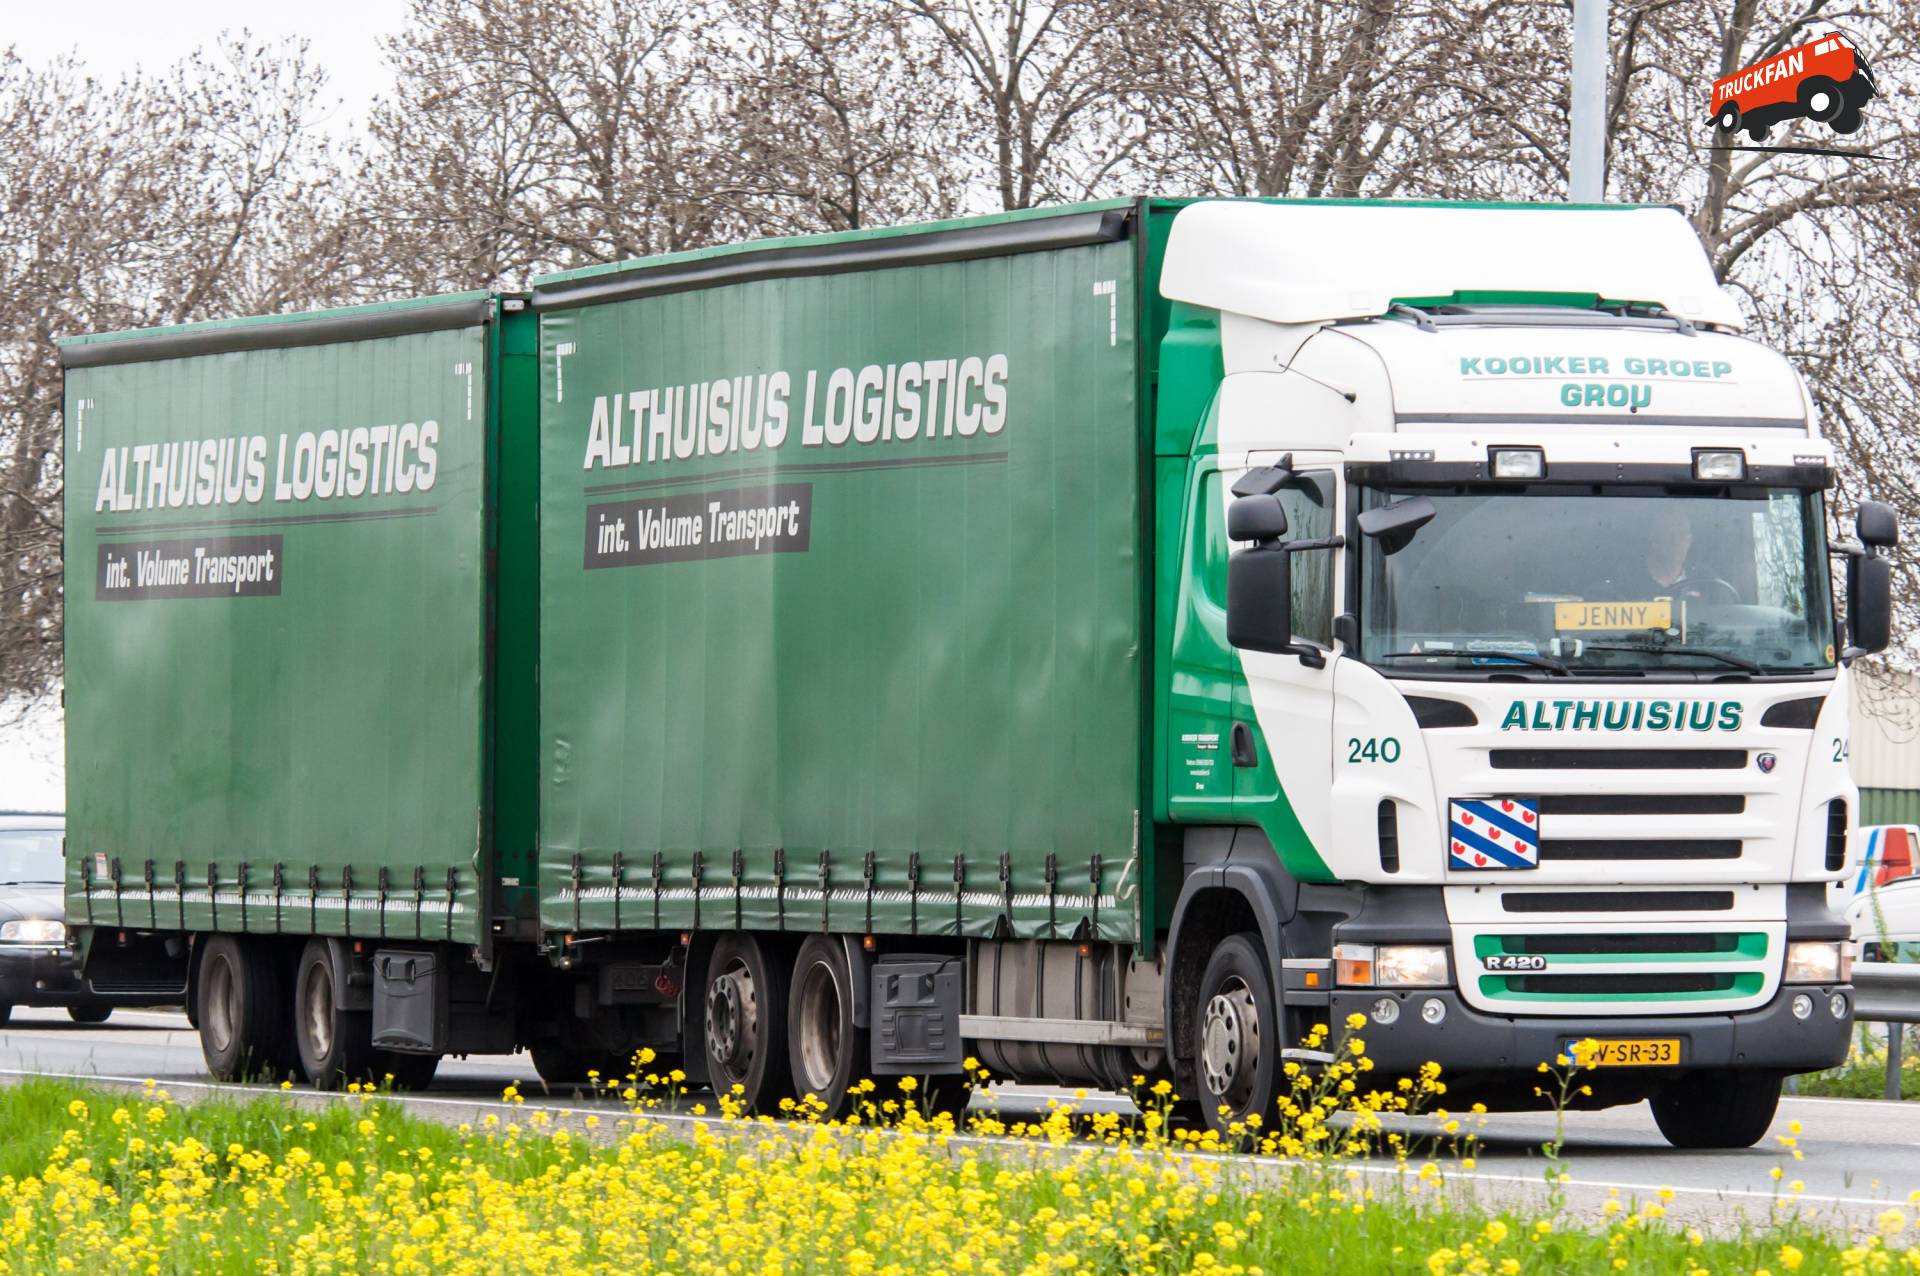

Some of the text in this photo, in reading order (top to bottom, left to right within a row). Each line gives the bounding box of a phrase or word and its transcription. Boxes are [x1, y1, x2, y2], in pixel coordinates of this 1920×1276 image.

[1459, 356, 1732, 378] KOOIKER GROEP
[583, 354, 1008, 470] ALTHUISIUS LOGISTICS
[95, 420, 439, 512] ALTHUISIUS LOGISTICS
[597, 500, 800, 554] int. Volume Transport
[106, 547, 274, 593] int. Volume Transport
[1578, 606, 1648, 626] JENNY
[1500, 700, 1744, 731] ALTHUISIUS
[1348, 737, 1401, 763] 240
[1486, 956, 1545, 970] R 420
[1588, 1043, 1671, 1062] V-SR-33
